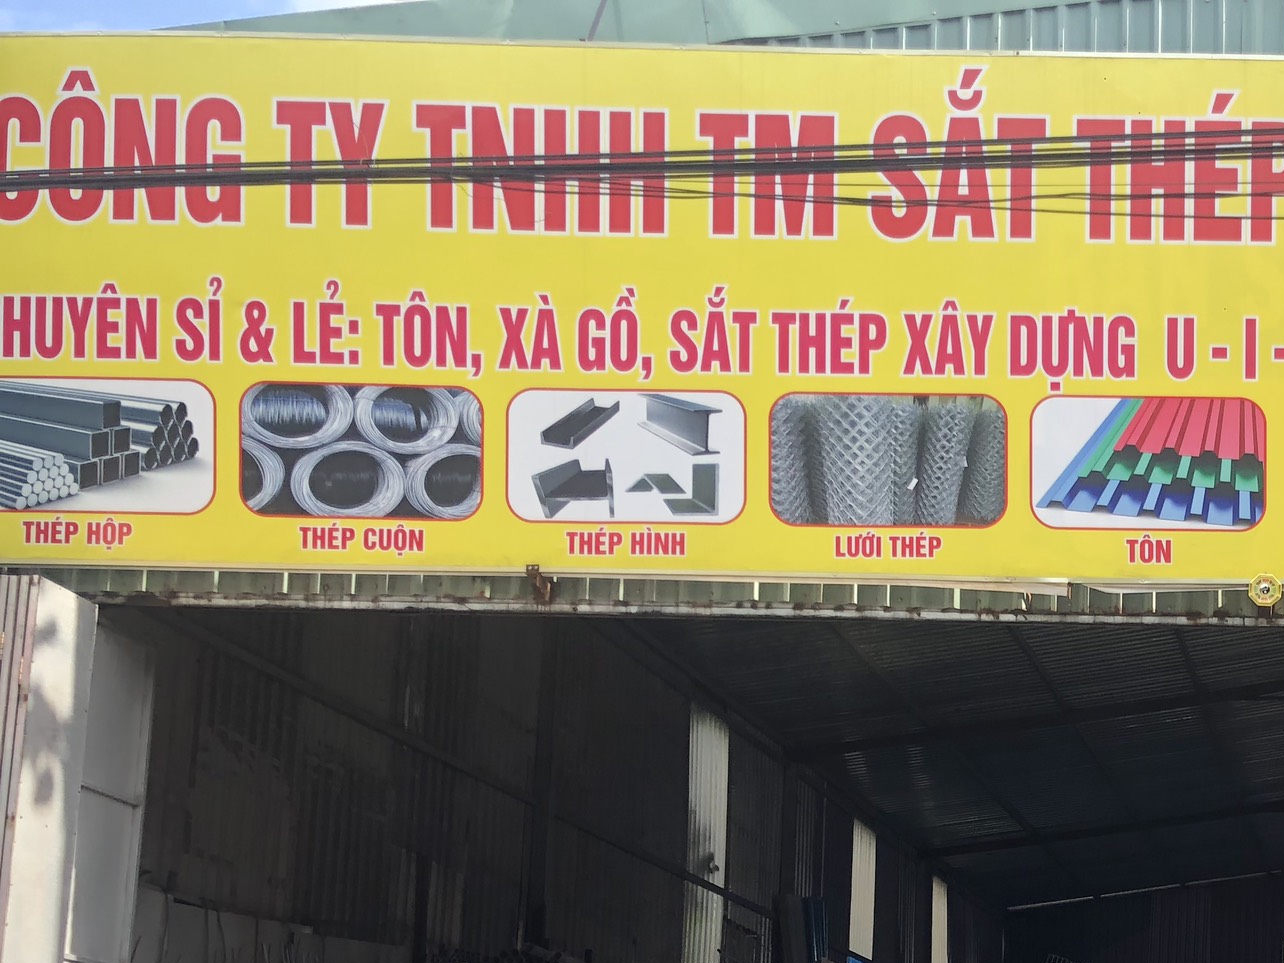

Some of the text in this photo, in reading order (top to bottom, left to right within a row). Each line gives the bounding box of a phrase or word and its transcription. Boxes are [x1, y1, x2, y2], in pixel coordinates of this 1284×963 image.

[0, 71, 241, 222] CÔNG
[278, 102, 383, 224] TY
[417, 105, 664, 233] TNHH
[700, 114, 834, 236] TM
[872, 70, 1045, 238] SẮT
[176, 278, 221, 360] SỈ
[240, 301, 273, 362] &
[294, 281, 358, 364] LẺ:
[376, 292, 481, 376] TÔN,
[500, 296, 560, 369] XÀ
[579, 288, 651, 378] GỒ,
[671, 288, 756, 372] SẮT
[772, 300, 886, 374] THÉP
[904, 301, 992, 375] XÂY
[1010, 310, 1135, 391] DỰNG
[1168, 318, 1194, 379] U
[1246, 319, 1256, 379] I
[24, 517, 132, 549] THÉP HỘP
[300, 523, 424, 556] THÉP CUỘN
[566, 528, 686, 556] THÉP HÌNH
[835, 530, 942, 558] LƯỚI THÉP
[1126, 535, 1172, 564] TÔN
